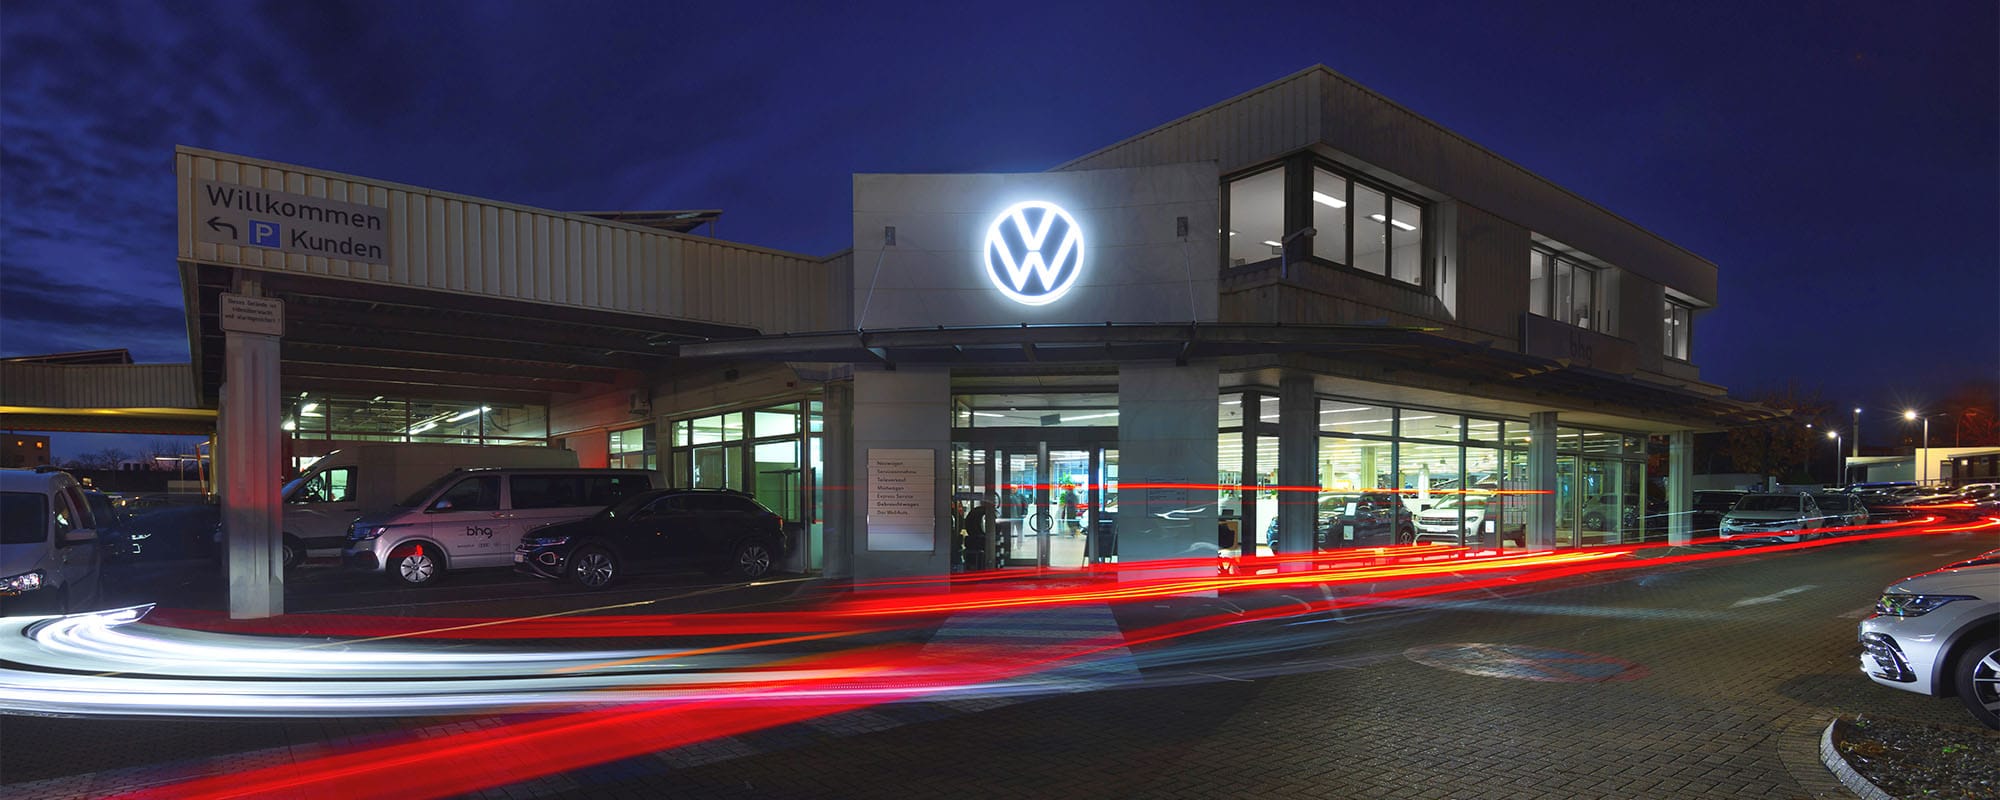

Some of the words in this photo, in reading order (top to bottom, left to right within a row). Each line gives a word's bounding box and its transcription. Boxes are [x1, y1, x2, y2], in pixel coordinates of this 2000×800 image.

[206, 184, 381, 230] Willkommen
[255, 223, 273, 243] P
[291, 228, 382, 260] Kunden
[466, 526, 493, 539] bhg
